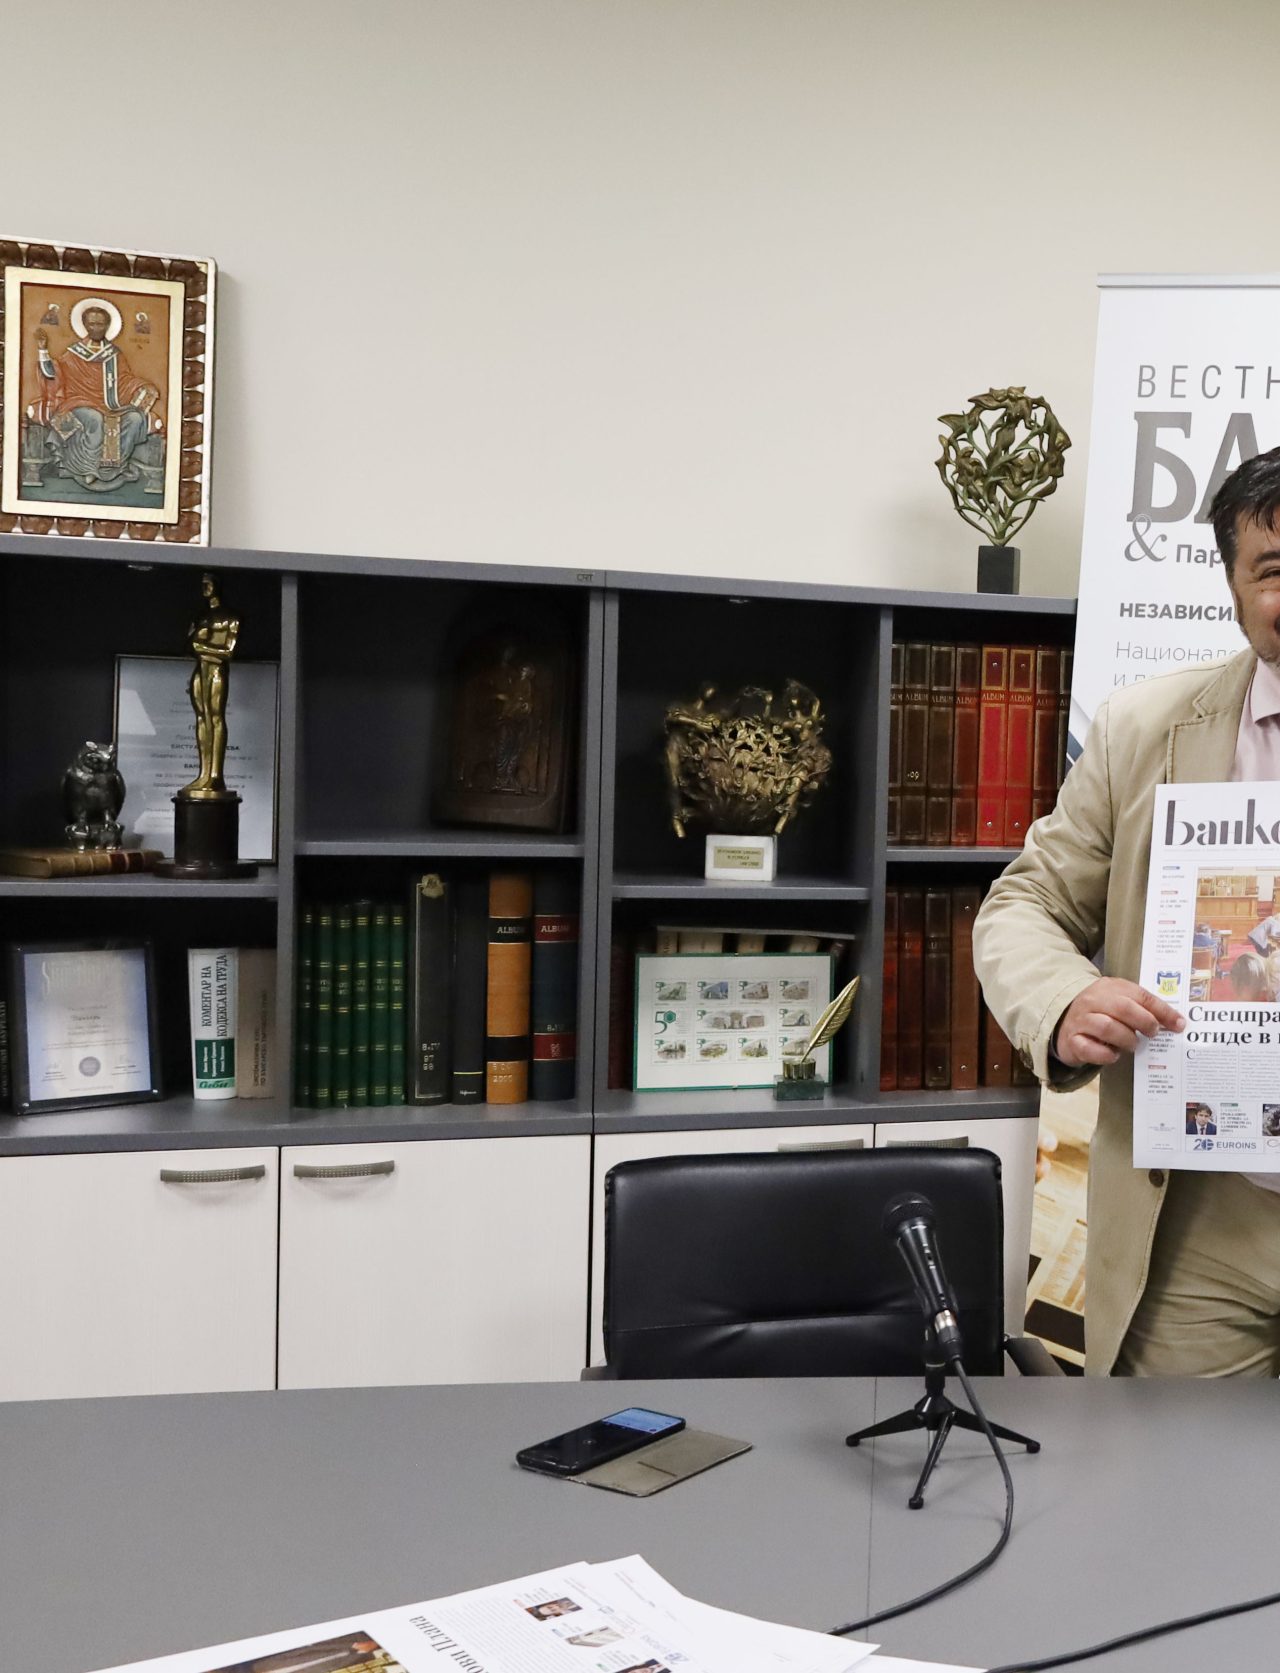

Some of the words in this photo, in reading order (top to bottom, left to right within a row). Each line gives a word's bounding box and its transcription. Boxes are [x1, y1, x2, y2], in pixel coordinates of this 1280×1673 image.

[1176, 543, 1224, 568] Пар
[1119, 602, 1238, 622] НЕЗАВИСИ
[982, 692, 1005, 702] ALBUM
[201, 966, 211, 978] НА
[215, 954, 228, 983] ТРУДА
[216, 984, 228, 995] НА
[201, 980, 212, 1027] КОМЕНТАР
[216, 997, 229, 1037] КОДЕКСА
[1186, 1030, 1252, 1046] отиде
[1259, 1033, 1271, 1044] в
[1216, 1141, 1257, 1150] EUROINS
[450, 1650, 487, 1673] ови
